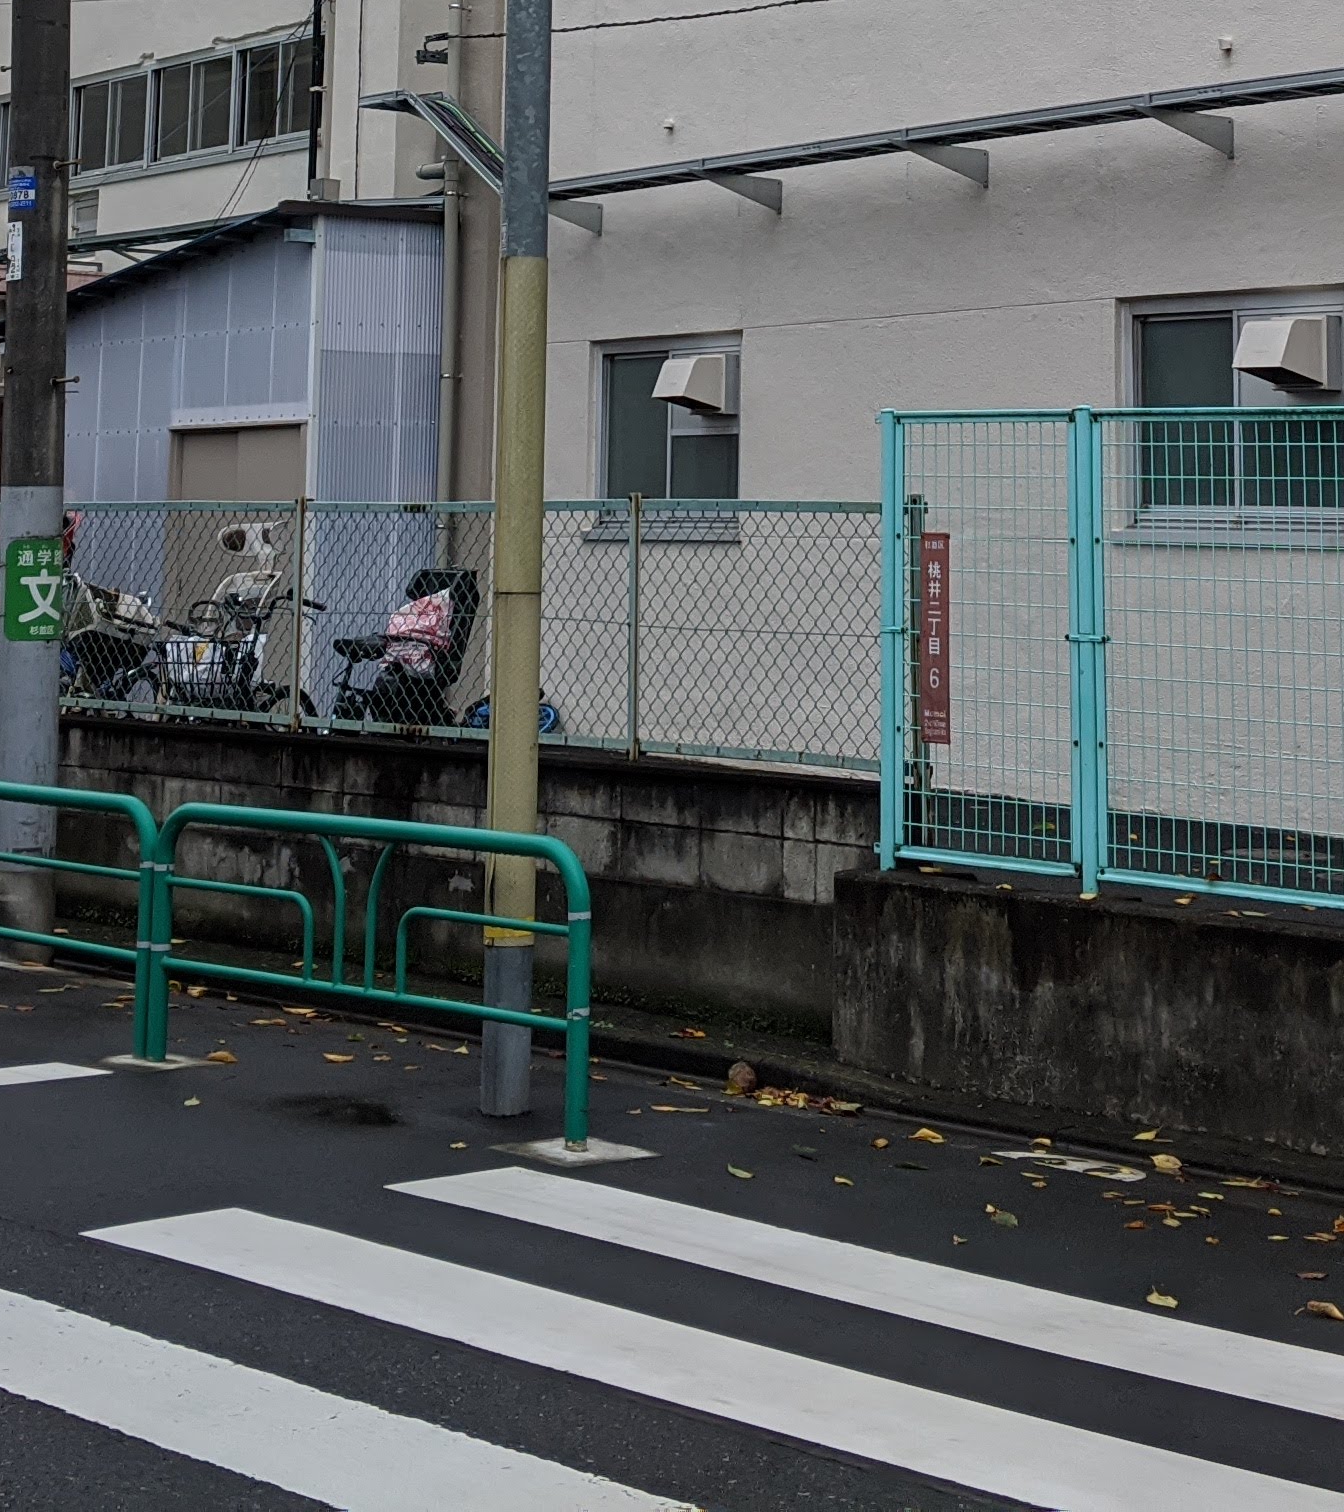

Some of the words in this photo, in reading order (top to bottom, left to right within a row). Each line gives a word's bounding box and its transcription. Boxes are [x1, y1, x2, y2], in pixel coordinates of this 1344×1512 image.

[18, 569, 60, 622] 文
[927, 560, 942, 656] 桃井二丁目
[929, 667, 940, 689] 6
